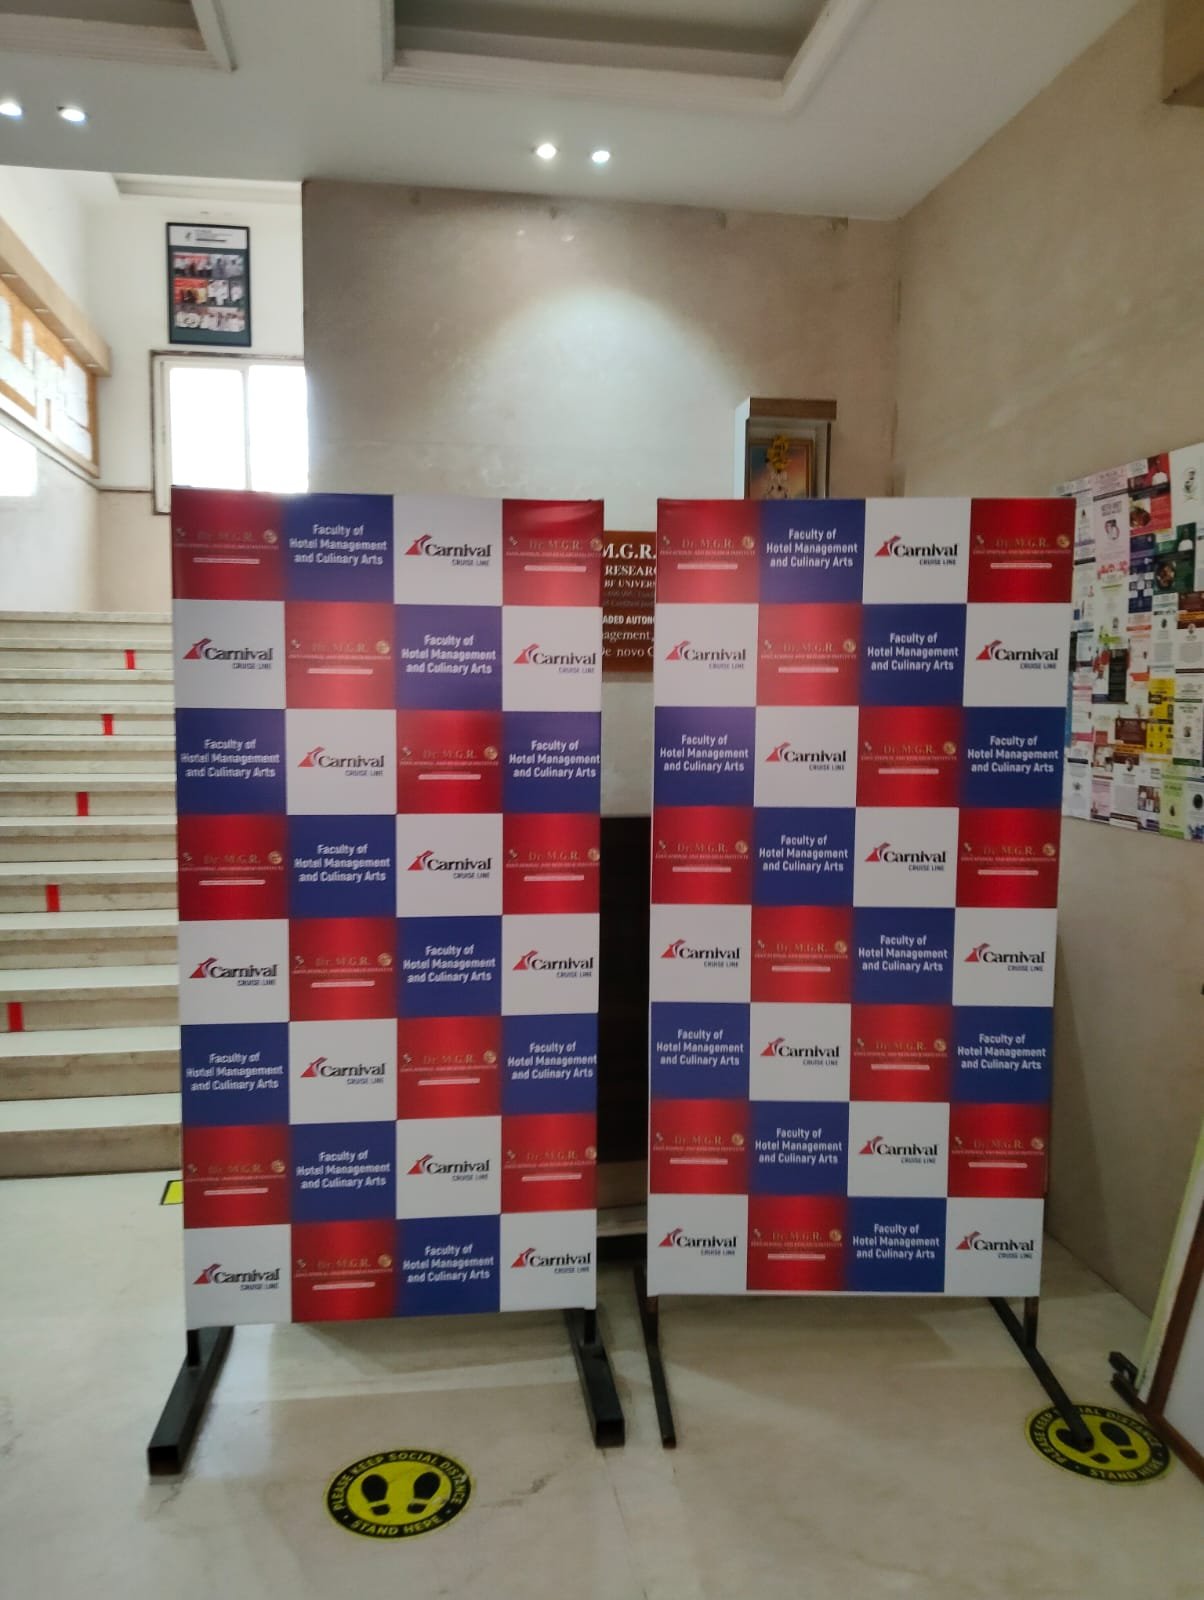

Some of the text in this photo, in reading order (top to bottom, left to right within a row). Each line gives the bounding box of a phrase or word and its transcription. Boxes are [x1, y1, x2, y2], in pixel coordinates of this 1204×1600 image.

[788, 529, 836, 541] Faculty of
[424, 542, 490, 557] Carnival
[766, 543, 791, 553] Hotel
[794, 543, 857, 556] Management
[893, 543, 957, 557] Carnival
[770, 557, 853, 569] and Culinary Arts
[602, 615, 655, 625] ADED AUTON
[423, 635, 474, 647] Faculty of
[889, 633, 937, 645] Faculty of
[401, 649, 428, 659] Hotel
[431, 649, 495, 662] Management
[617, 648, 645, 656] novo
[683, 648, 745, 660] Carnival
[867, 647, 892, 656] Hotel
[895, 647, 958, 659] Management
[994, 647, 1058, 661] Carnival
[405, 663, 492, 676] and Culinary Arts
[870, 660, 953, 673] and Culinary Arts
[531, 741, 578, 752] Faculty of
[681, 735, 727, 747] Faculty of
[508, 754, 535, 764] Hotel
[537, 754, 600, 766] Management
[660, 748, 748, 760] Hotel Management
[783, 749, 846, 762] Carnival
[513, 768, 595, 780] and Culinary Arts
[663, 761, 744, 774] and Culinary Arts
[780, 835, 827, 847] Faculty of
[759, 848, 783, 858] Hotel
[786, 848, 848, 861] Management
[883, 849, 946, 863] Carnival
[762, 861, 843, 874] and Culinary Arts
[880, 935, 926, 947] Faculty of
[678, 946, 740, 959] Carnival
[858, 948, 883, 957] Hotel
[886, 948, 947, 960] Management
[982, 950, 1044, 963] Carnival
[209, 963, 276, 978] Carnival
[862, 961, 943, 973] and Culinary Arts
[677, 1029, 723, 1041] Faculty of
[529, 1042, 576, 1055] Faculty of
[656, 1042, 743, 1055] Hotel Management
[778, 1044, 839, 1058] Carnival
[507, 1054, 597, 1068] Hotel Management
[660, 1055, 739, 1067] and Culinary Arts
[511, 1068, 593, 1081] and Culinary Arts
[776, 1128, 821, 1140] Faculty of
[755, 1140, 779, 1150] Hotel
[782, 1141, 841, 1154] Management
[876, 1143, 937, 1156] Carnival
[758, 1153, 838, 1166] and Culinary Arts
[426, 1159, 489, 1174] Carnival
[873, 1224, 919, 1236] Faculty of
[676, 1235, 736, 1248] Carnival
[852, 1236, 876, 1246] Hotel
[879, 1237, 939, 1249] Management
[856, 1249, 935, 1261] and Culinary Arts
[331, 1452, 467, 1511] PLEASE KEEP SOCIAL DISTANCE
[350, 1515, 442, 1536] STAND HERE
